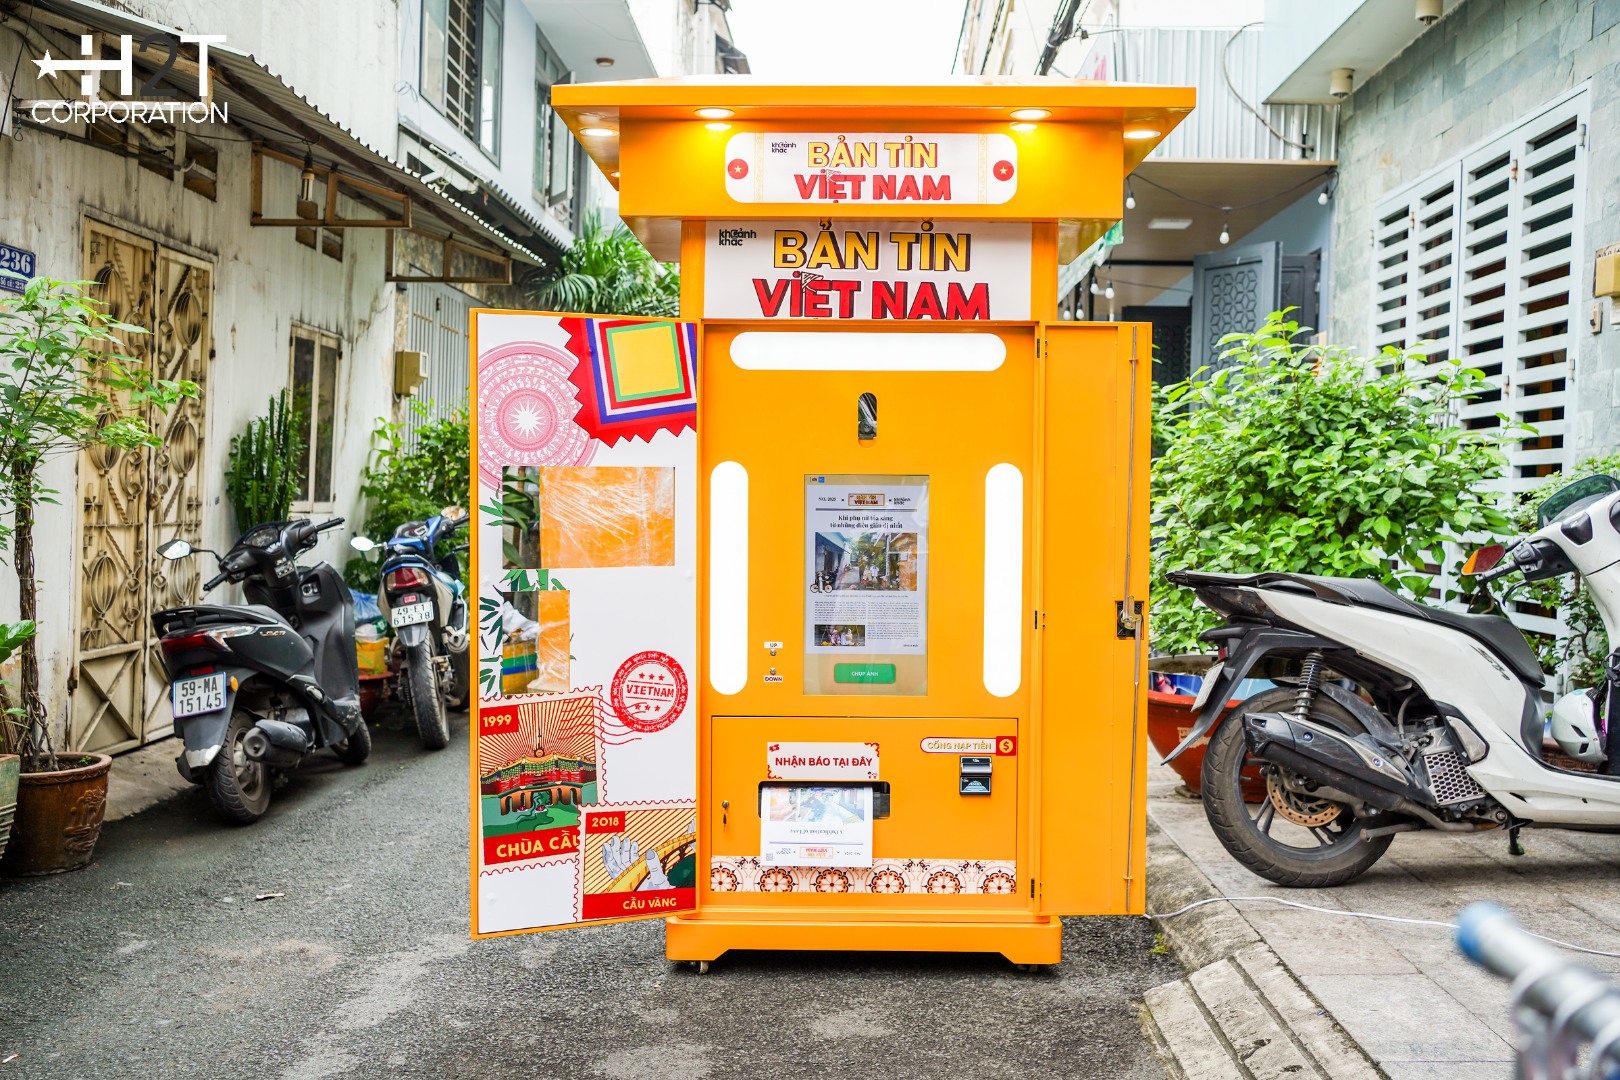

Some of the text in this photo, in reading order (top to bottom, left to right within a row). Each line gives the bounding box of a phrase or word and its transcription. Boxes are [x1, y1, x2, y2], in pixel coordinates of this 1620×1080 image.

[807, 134, 877, 168] BẢN
[872, 174, 952, 201] NAM
[773, 220, 880, 270] BẢN
[0, 248, 31, 274] 236
[872, 281, 990, 320] NAM
[181, 676, 217, 697] 59-MA
[626, 684, 675, 698] VIETNAM
[179, 692, 222, 714] 151.45
[482, 713, 512, 728] 1999
[775, 754, 873, 769] NHẬN BÁO TẠI ĐÂY
[591, 816, 619, 827] 2018
[495, 837, 545, 858] CHÙA
[622, 896, 677, 910] CẦU VÀNG
